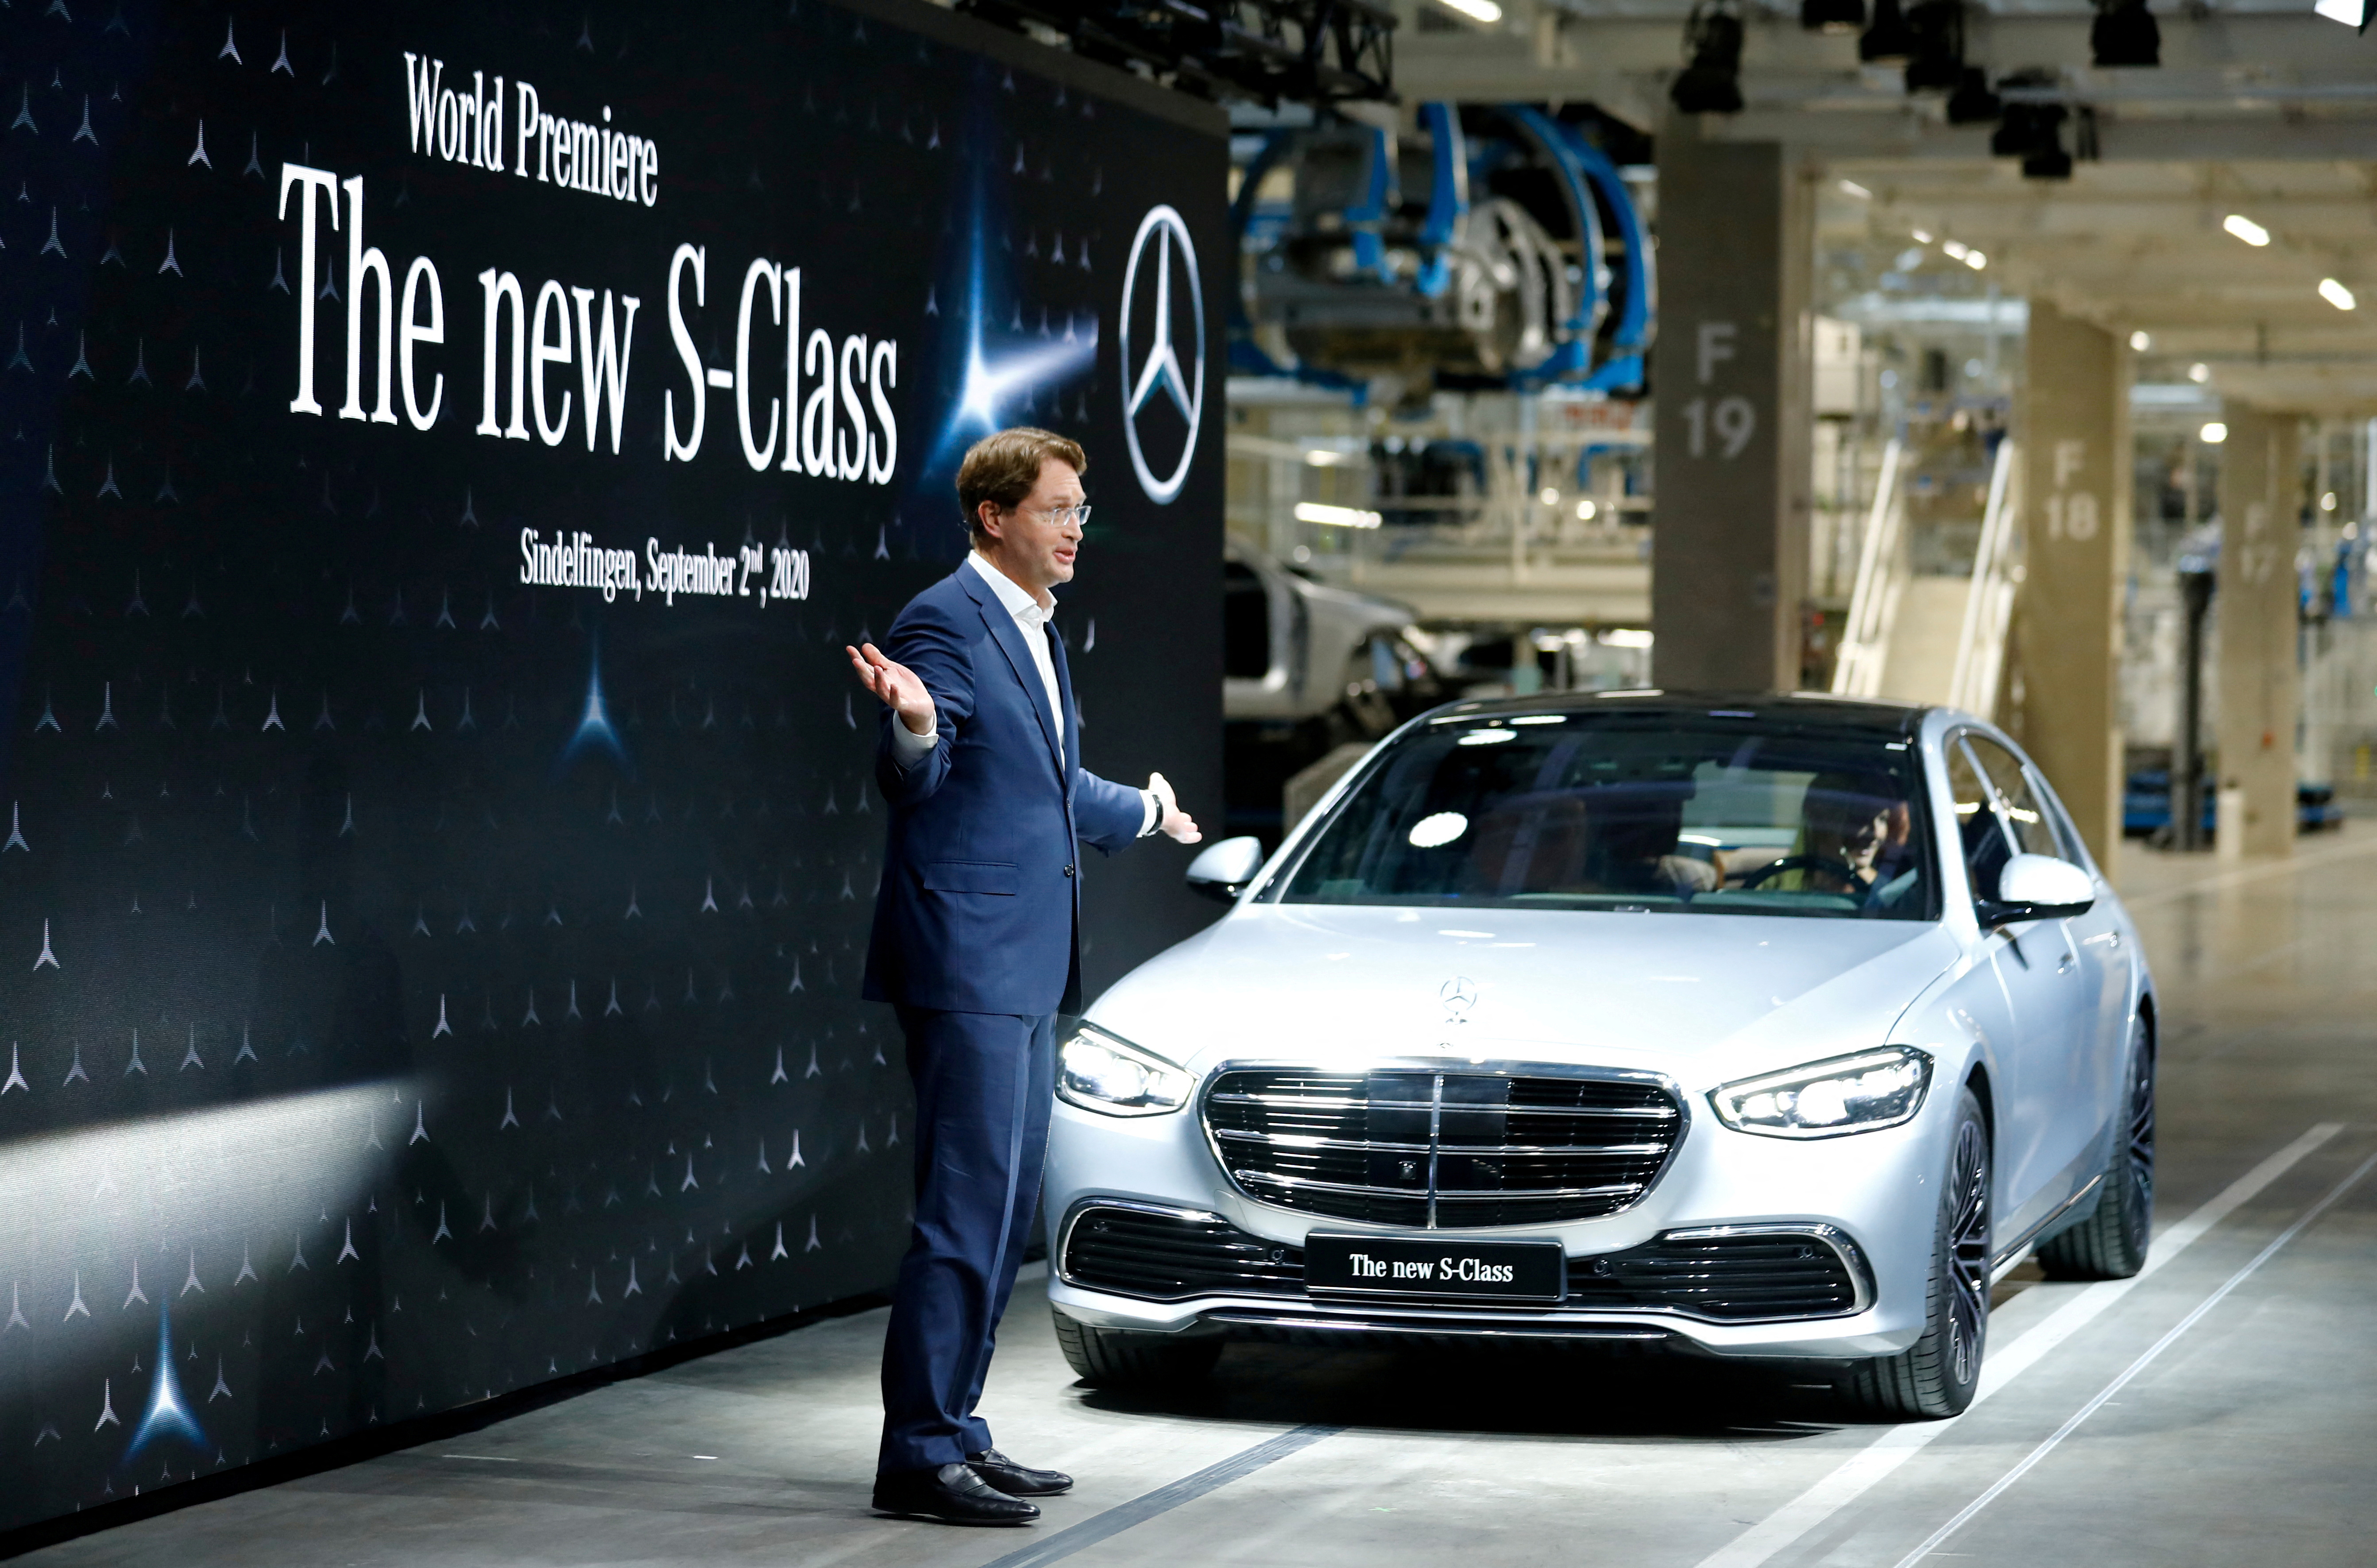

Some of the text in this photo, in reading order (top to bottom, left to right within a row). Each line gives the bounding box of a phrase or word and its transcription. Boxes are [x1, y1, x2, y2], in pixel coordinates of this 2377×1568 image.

[403, 51, 658, 208] World Premiere
[278, 162, 897, 486] The new S-Class
[1697, 321, 1736, 384] F
[1684, 397, 1755, 459] 19
[2055, 440, 2085, 487] F
[2043, 492, 2099, 541] 18
[520, 527, 642, 603] Sindelfingen,
[646, 537, 737, 606] September
[769, 547, 810, 601] 2020
[1349, 1254, 1514, 1283] The new S-Class
